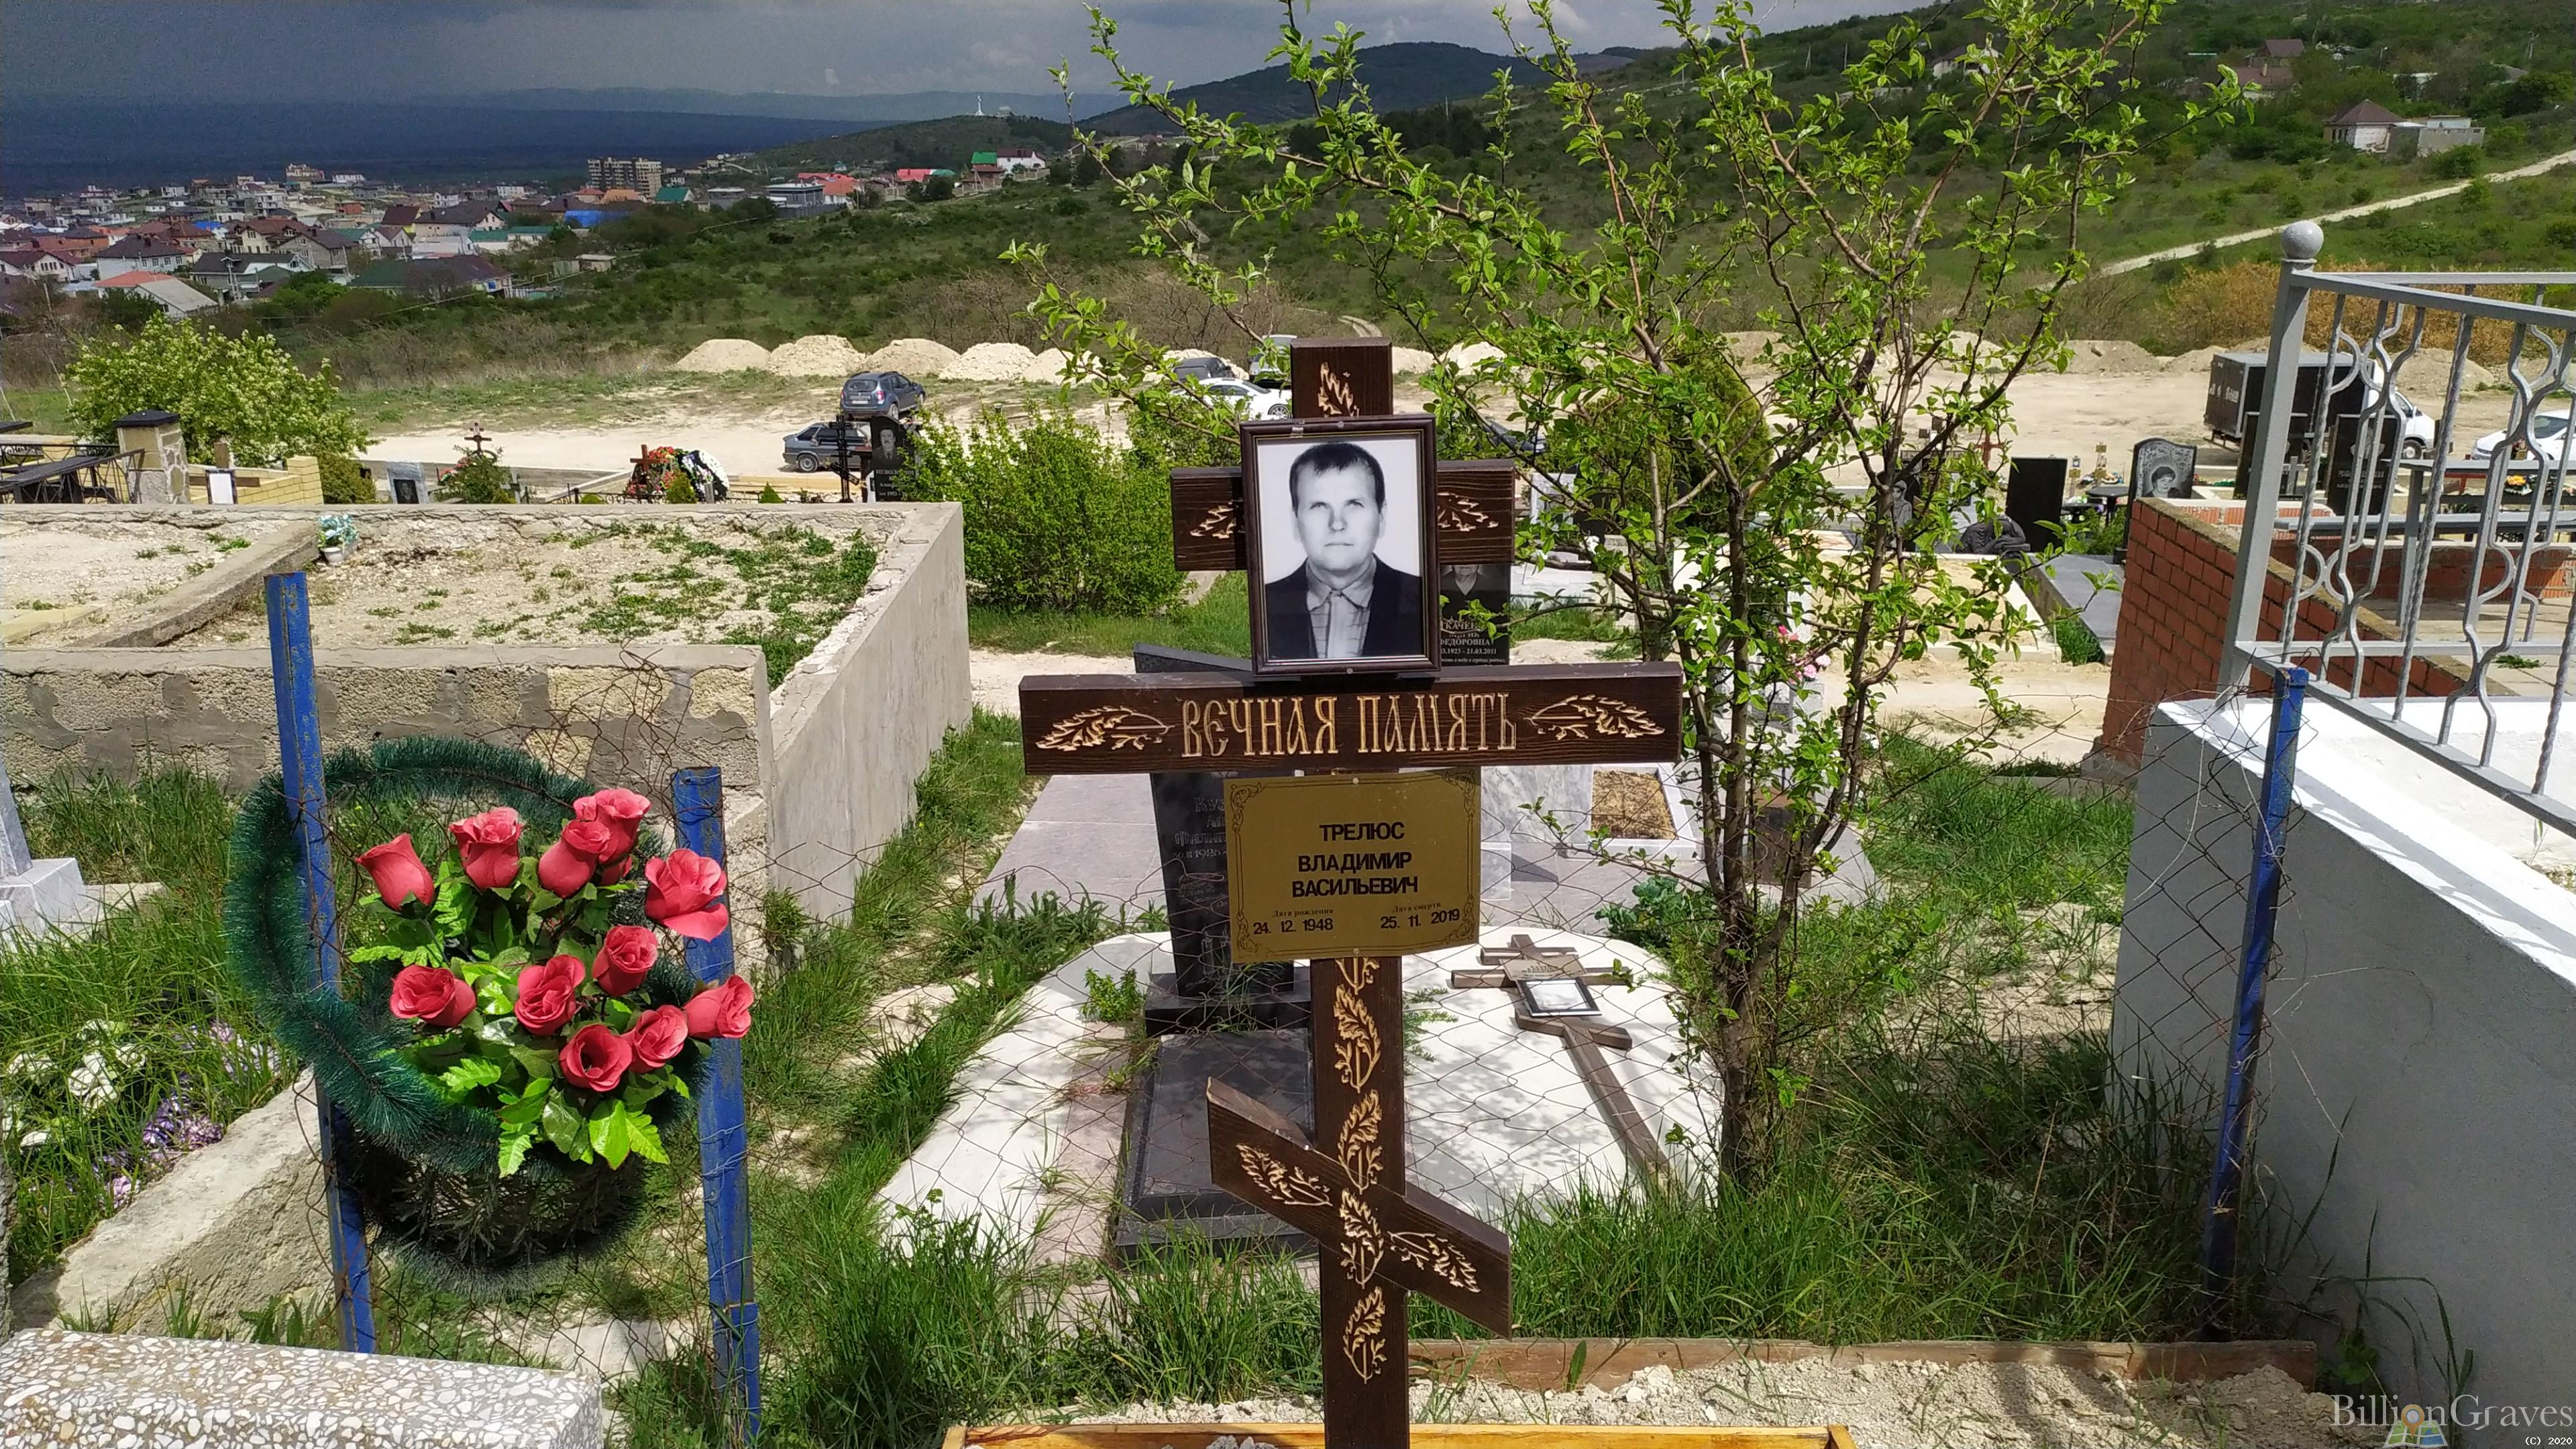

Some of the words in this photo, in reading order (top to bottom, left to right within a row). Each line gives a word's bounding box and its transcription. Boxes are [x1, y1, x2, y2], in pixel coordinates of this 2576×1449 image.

[1181, 696, 1338, 758] ВЕЧНАЯ
[1357, 692, 1517, 753] ПАМЯТЬ
[1320, 822, 1405, 842] ТРЕЛЮС
[1298, 851, 1413, 873] ВЛАДИМИР
[1292, 876, 1419, 898] ВАСИЛЬЕВИЧ
[1272, 910, 1292, 918] Дата
[1293, 908, 1334, 918] рождения
[1392, 904, 1412, 913] Дата
[1413, 902, 1442, 912] смерти
[1253, 922, 1271, 935] 24.
[1281, 920, 1297, 933] 12.
[1302, 917, 1334, 932] 1948
[1380, 916, 1400, 930] 25.
[1407, 914, 1421, 928] 11.
[1431, 908, 1460, 925] 2019
